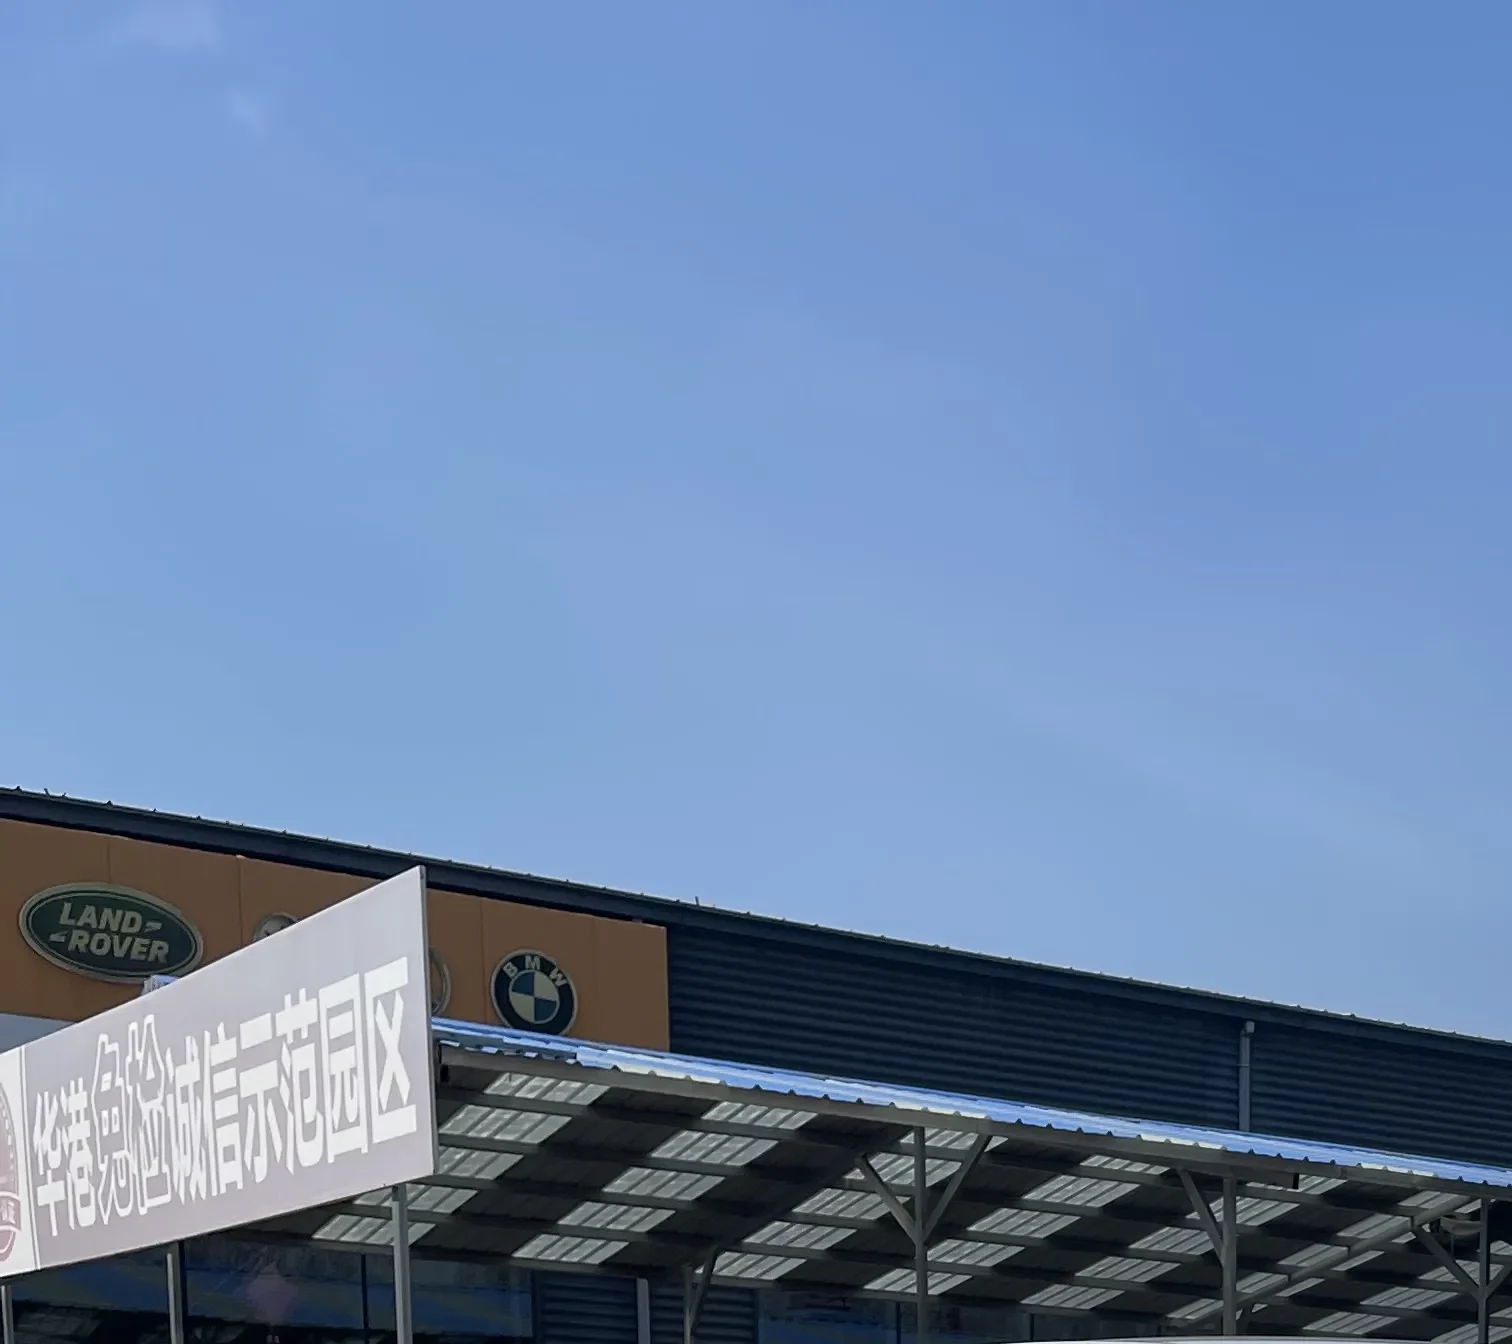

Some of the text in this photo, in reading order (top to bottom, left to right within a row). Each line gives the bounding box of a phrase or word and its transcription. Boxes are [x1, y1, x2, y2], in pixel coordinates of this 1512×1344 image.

[60, 902, 143, 934] LAND
[68, 930, 169, 963] ROVER
[503, 955, 568, 987] BMW
[33, 957, 417, 1236] 华港免检诚信示范园区
